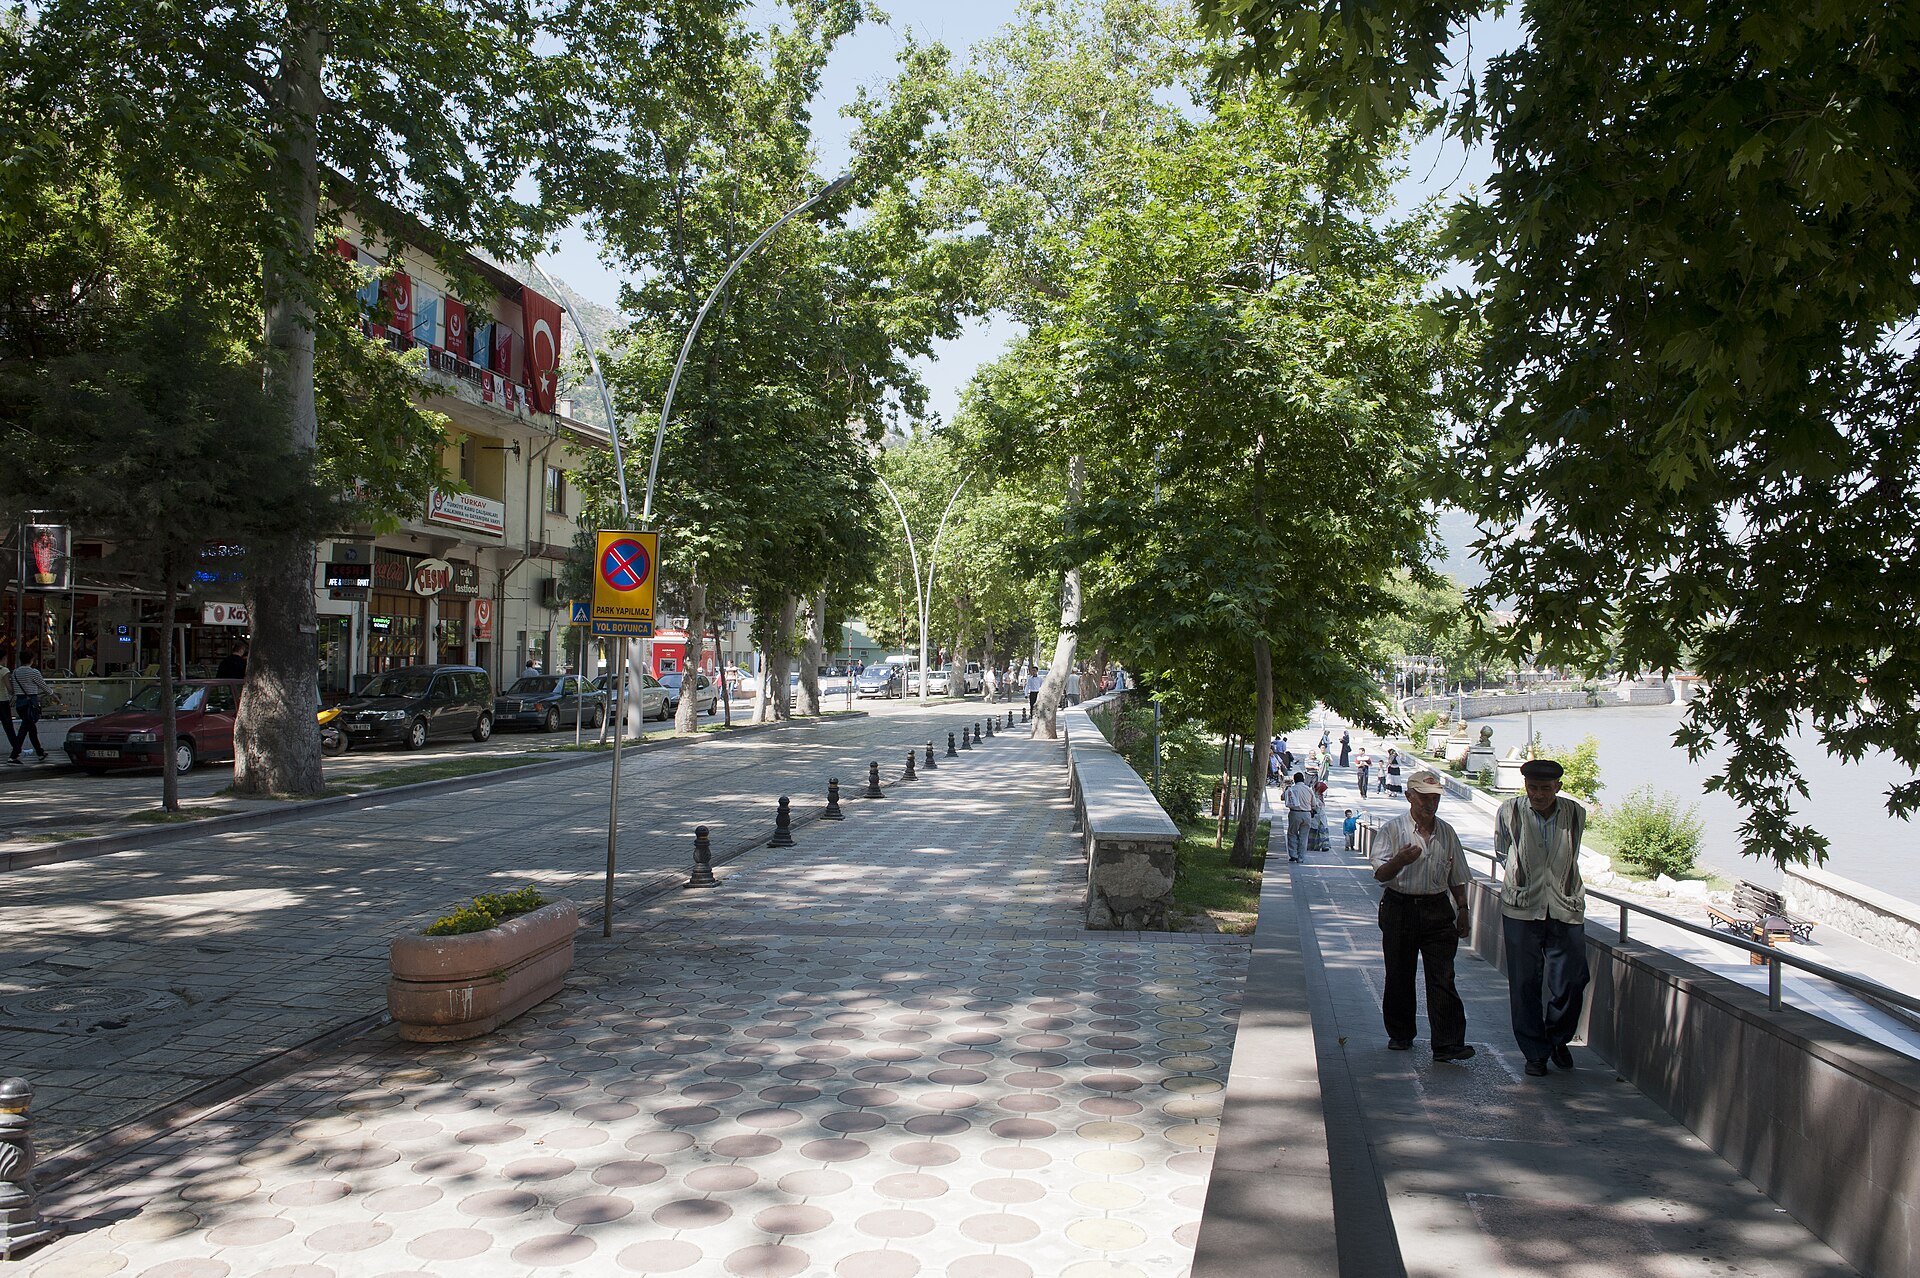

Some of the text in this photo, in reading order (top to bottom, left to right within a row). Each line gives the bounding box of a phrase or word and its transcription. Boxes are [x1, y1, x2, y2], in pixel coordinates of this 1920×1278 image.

[460, 568, 472, 576] cafe
[418, 566, 449, 592] ÇEŞNİ
[454, 584, 478, 594] fastfood
[596, 606, 650, 616] PARK YAPILMAZ
[596, 622, 648, 633] YOL BOYUNCA
